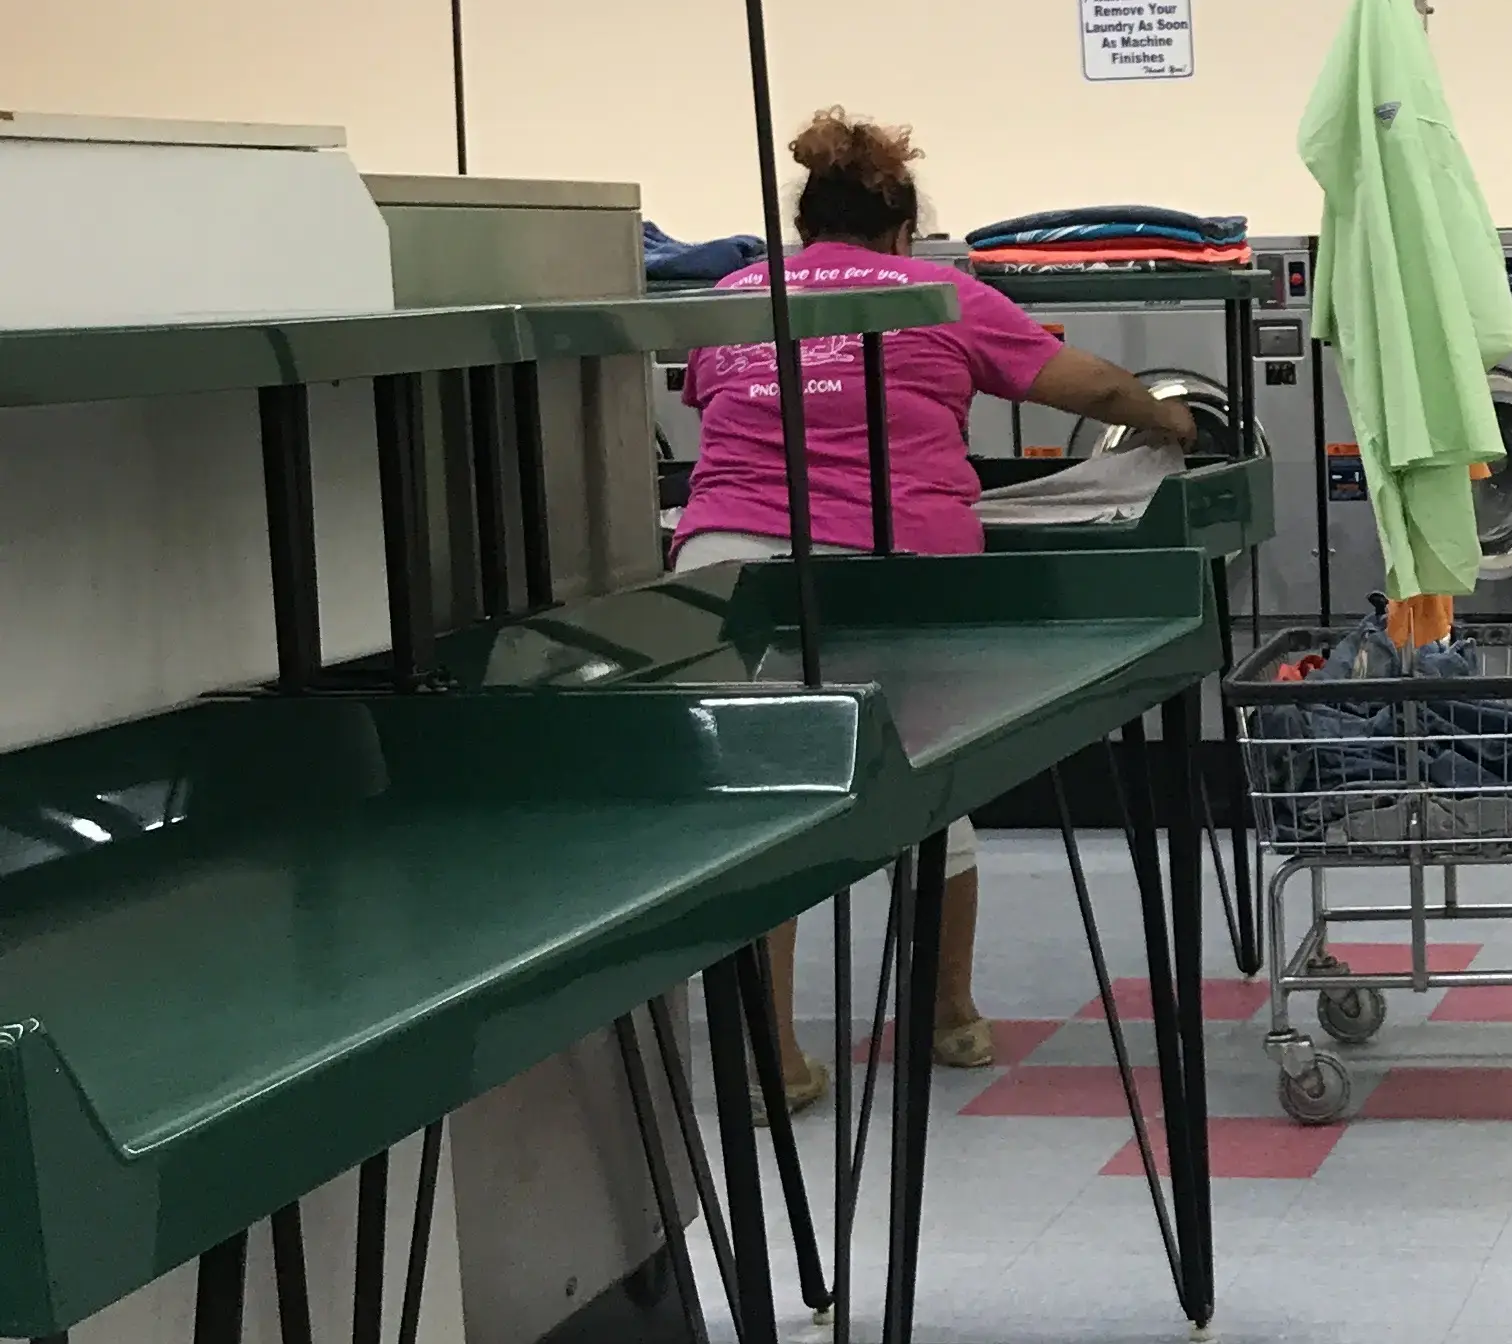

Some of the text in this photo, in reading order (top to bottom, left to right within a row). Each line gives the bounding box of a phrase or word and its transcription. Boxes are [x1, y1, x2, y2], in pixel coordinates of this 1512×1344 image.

[1094, 2, 1177, 16] Remove Your
[1086, 19, 1188, 34] Laundry As Soon
[1102, 35, 1173, 48] As Machine
[1112, 52, 1164, 64] Finishes
